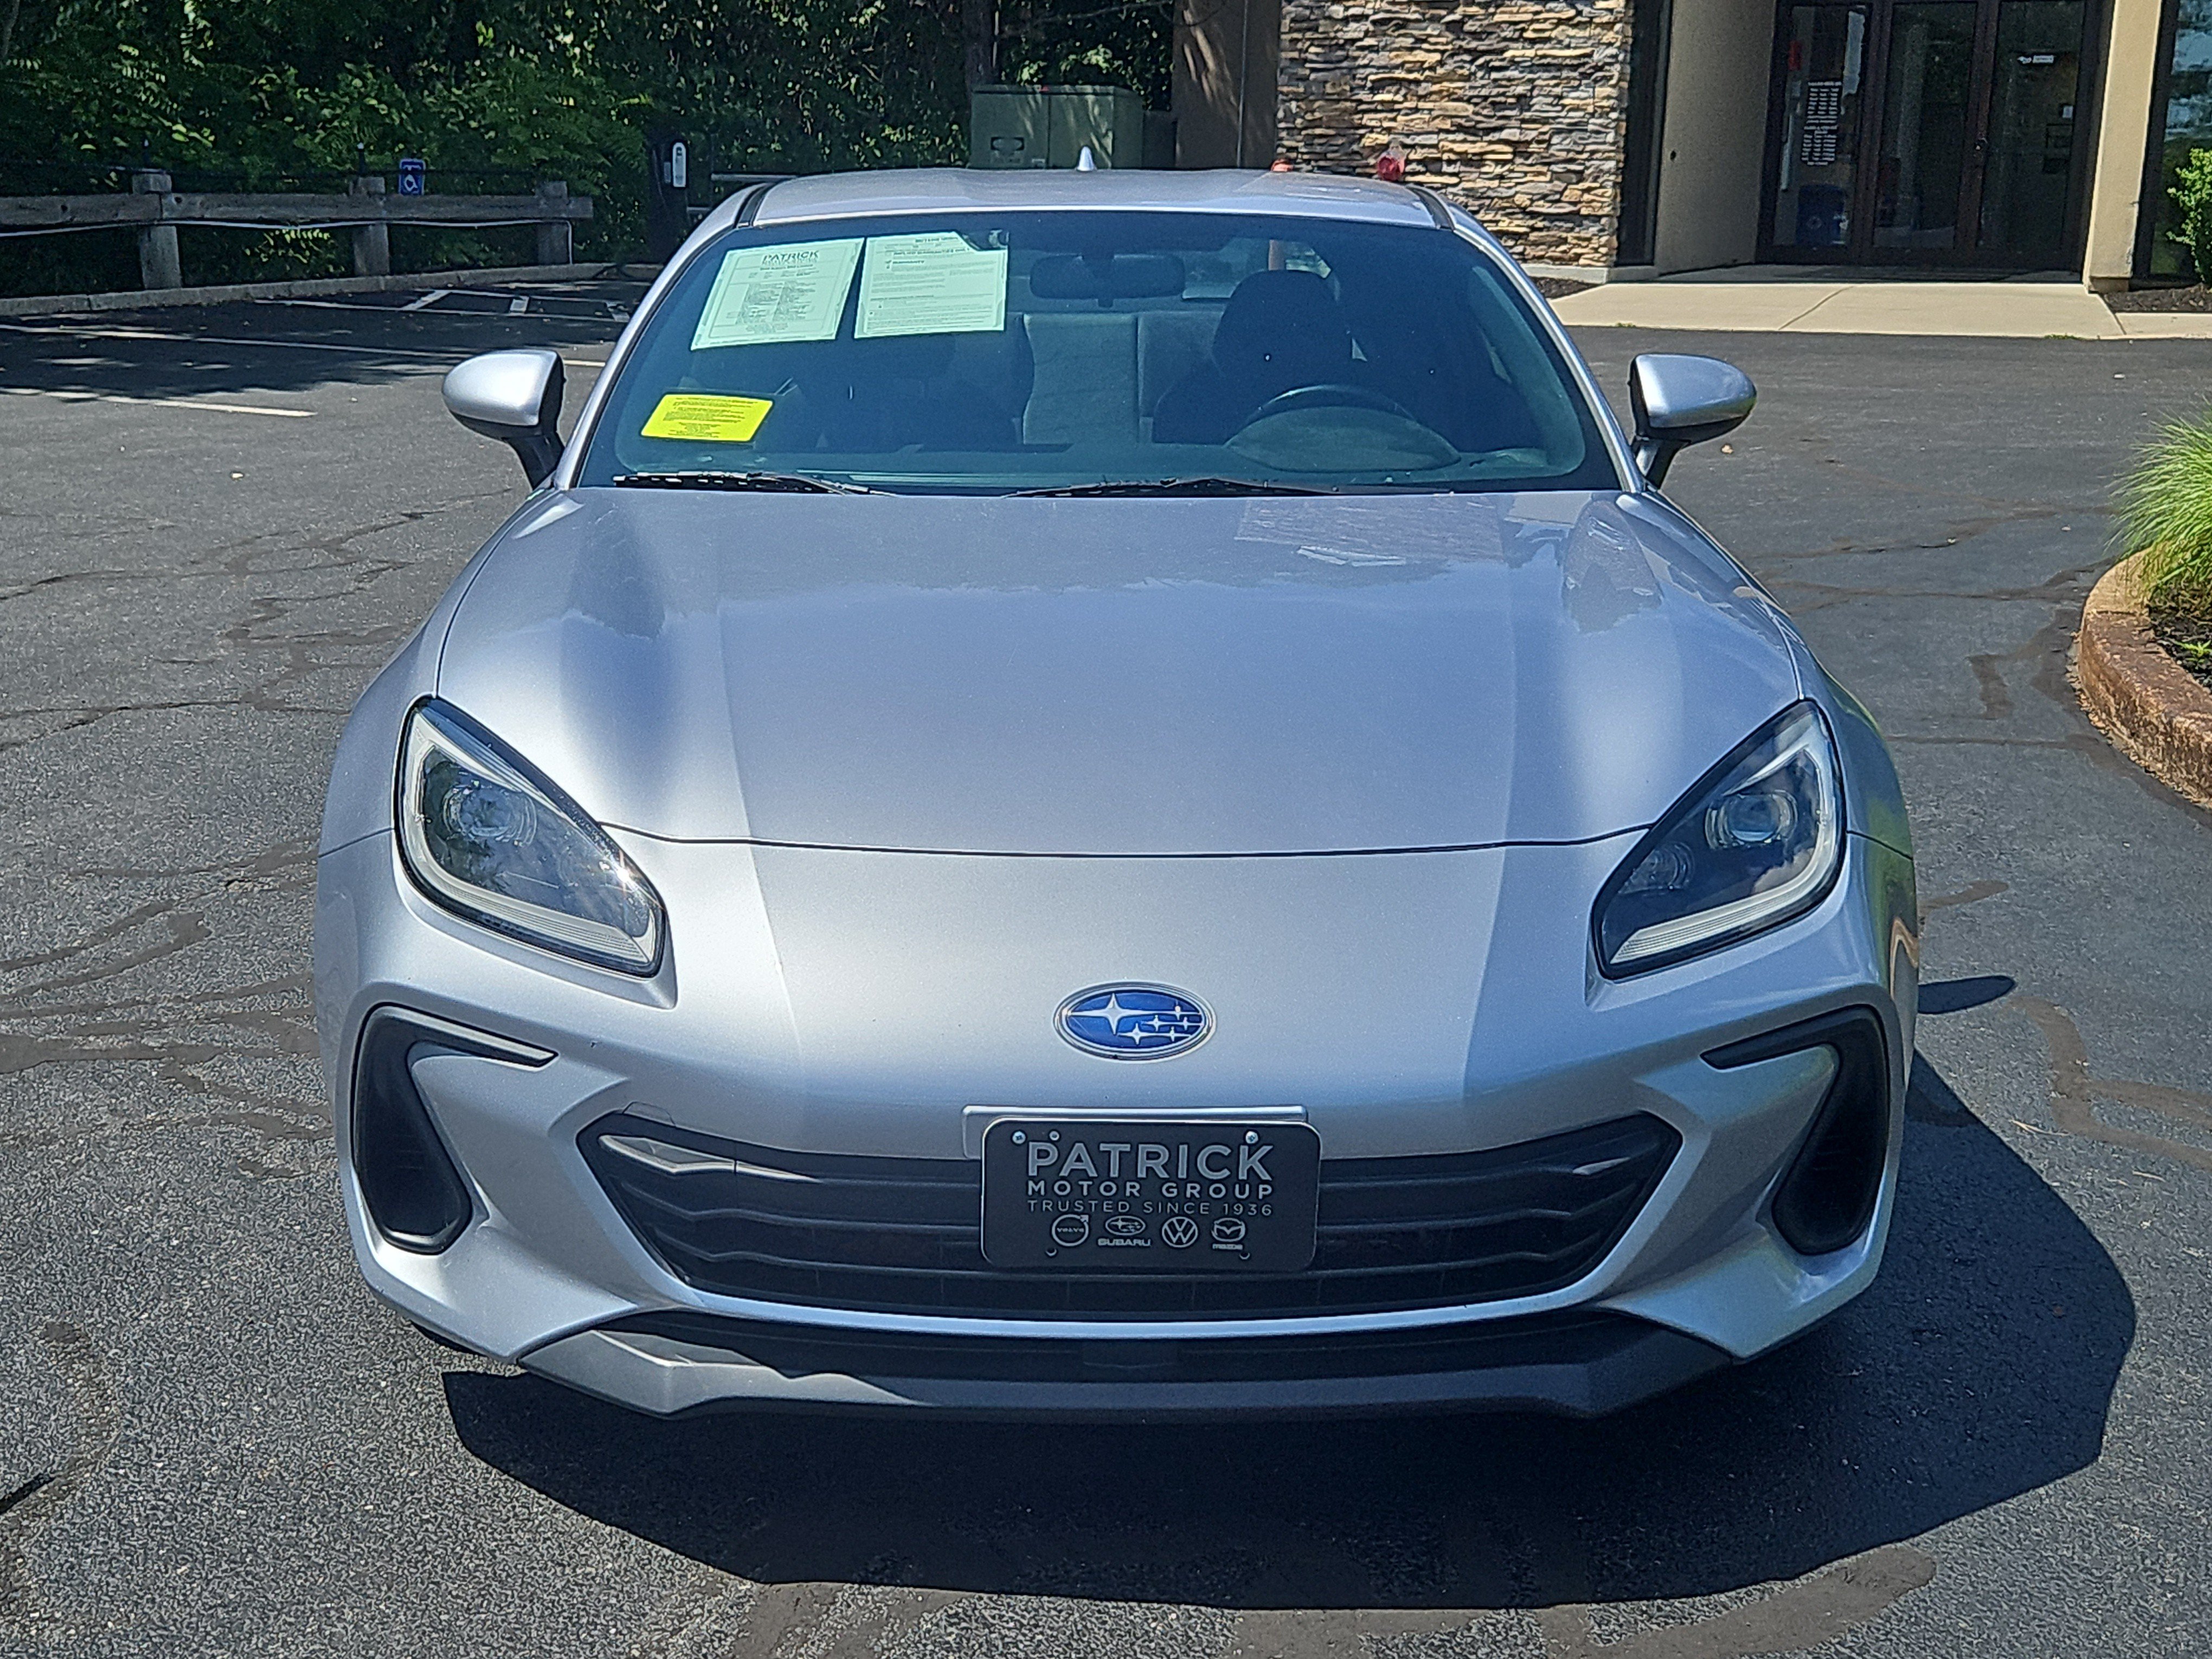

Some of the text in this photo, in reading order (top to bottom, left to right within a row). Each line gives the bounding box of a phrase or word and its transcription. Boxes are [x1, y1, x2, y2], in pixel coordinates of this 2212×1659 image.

[762, 250, 819, 265] PATRICK
[1028, 1141, 1273, 1181] PATRICK
[1027, 1180, 1272, 1199] MOTOR GROUP
[1027, 1200, 1272, 1216] TRUSTED SINCE 1936
[1097, 1238, 1151, 1246] SUBARU
